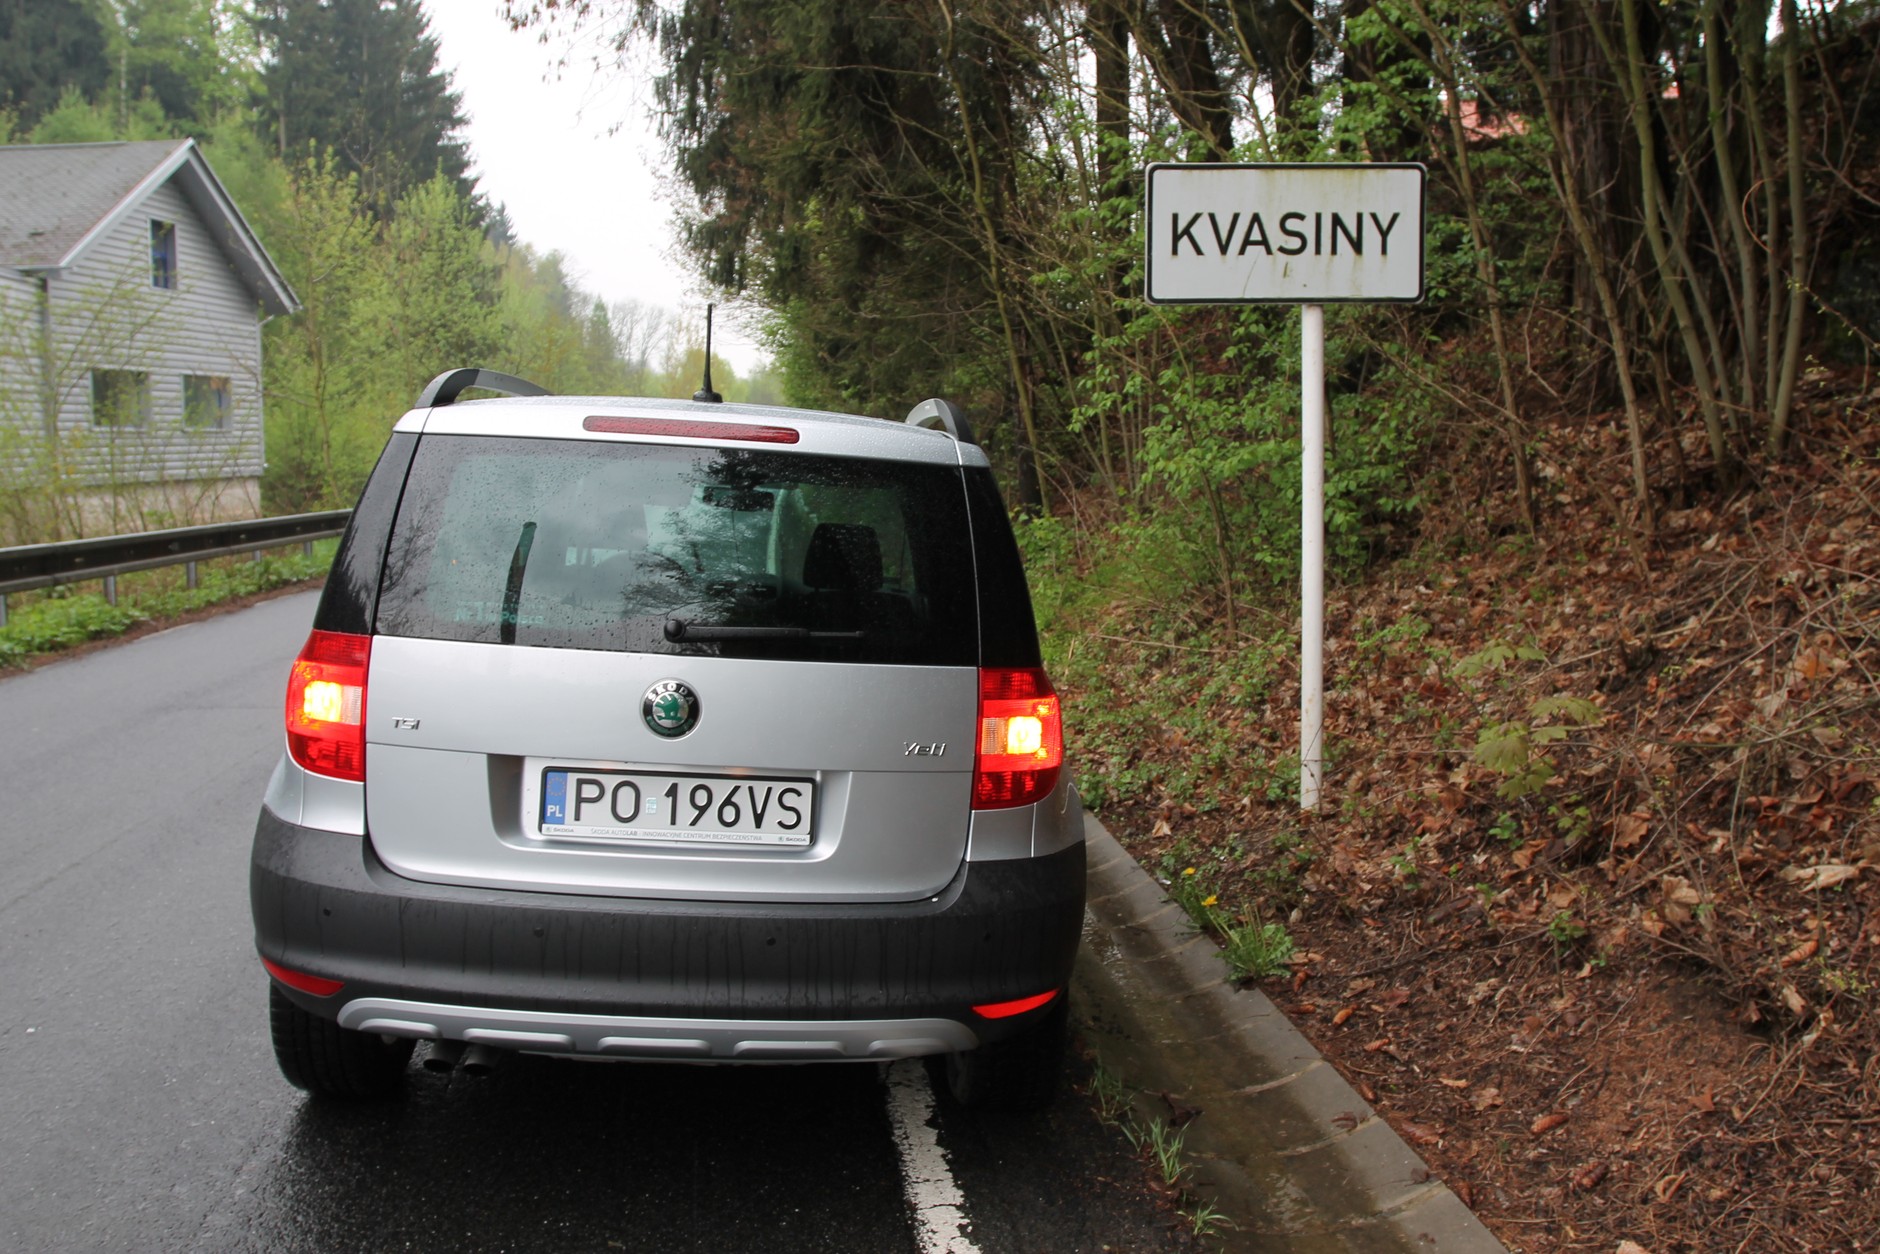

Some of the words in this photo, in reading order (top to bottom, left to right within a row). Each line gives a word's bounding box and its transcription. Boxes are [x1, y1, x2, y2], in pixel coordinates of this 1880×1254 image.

[1171, 211, 1401, 256] KVASINY
[391, 717, 420, 731] TSI
[902, 742, 947, 757] Yeti
[574, 778, 640, 824] PO
[662, 781, 803, 830] 196VS
[547, 805, 563, 818] PL
[683, 832, 710, 840] CENTRUM
